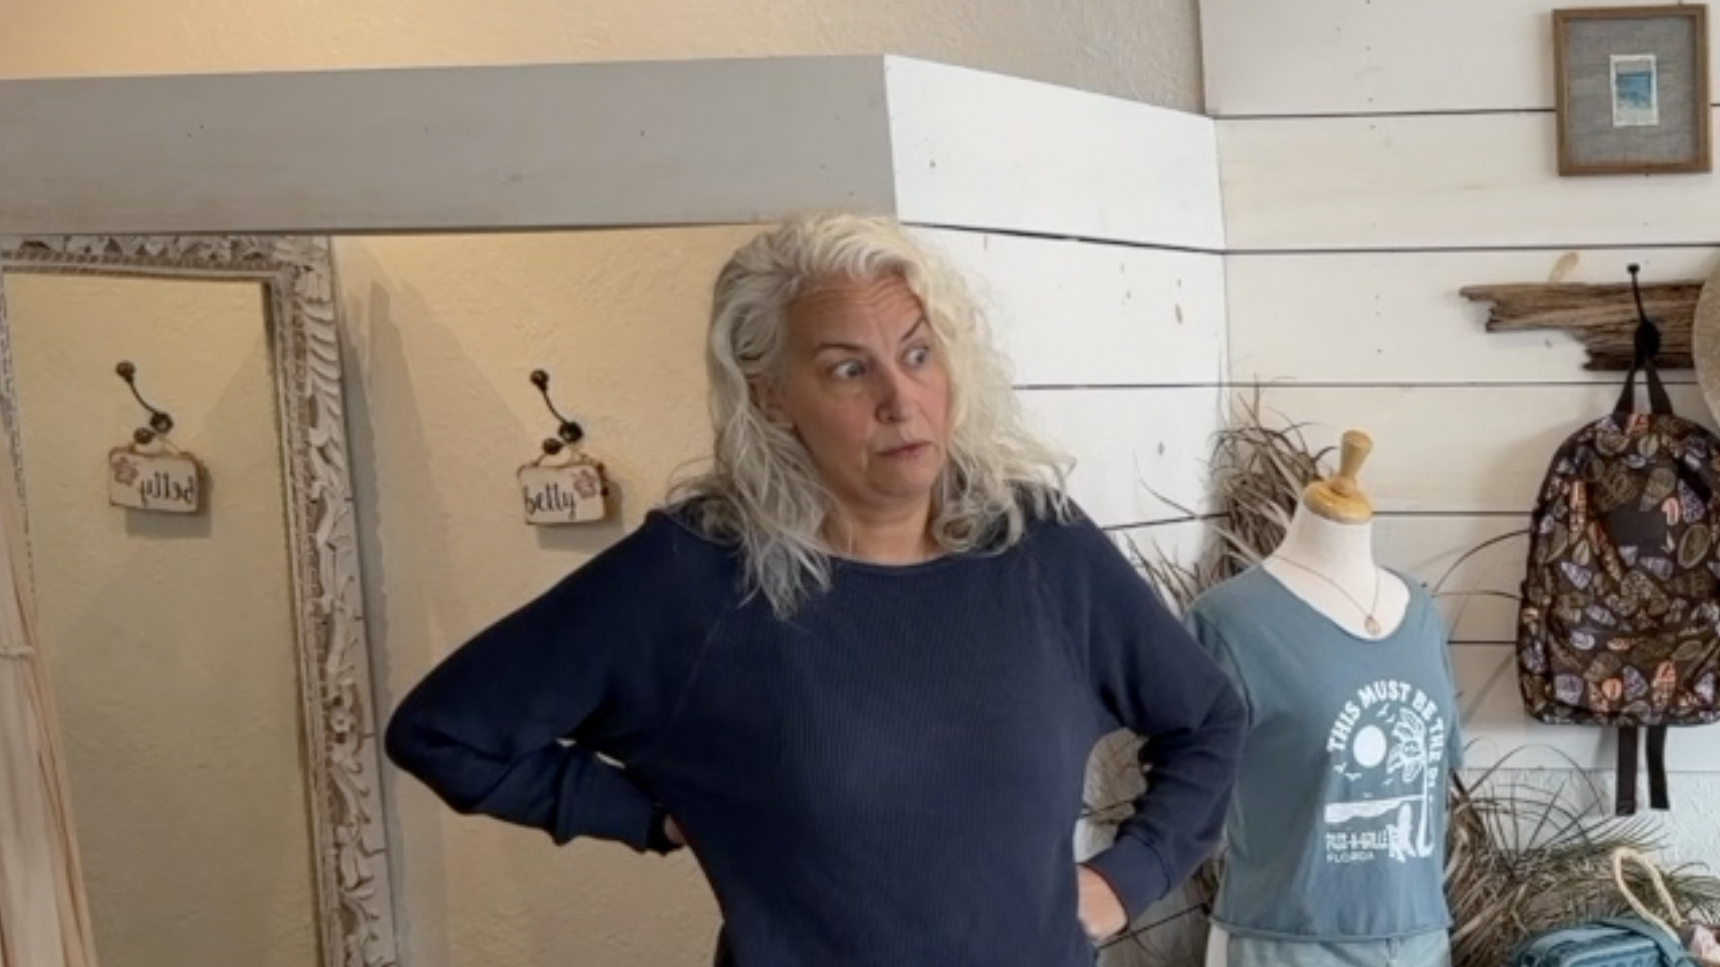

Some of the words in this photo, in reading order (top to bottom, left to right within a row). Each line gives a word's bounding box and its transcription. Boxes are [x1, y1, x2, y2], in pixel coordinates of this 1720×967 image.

[1326, 700, 1361, 753] THIS
[1357, 679, 1412, 709] MUST
[1412, 688, 1438, 721] BE
[1428, 716, 1444, 763] THE
